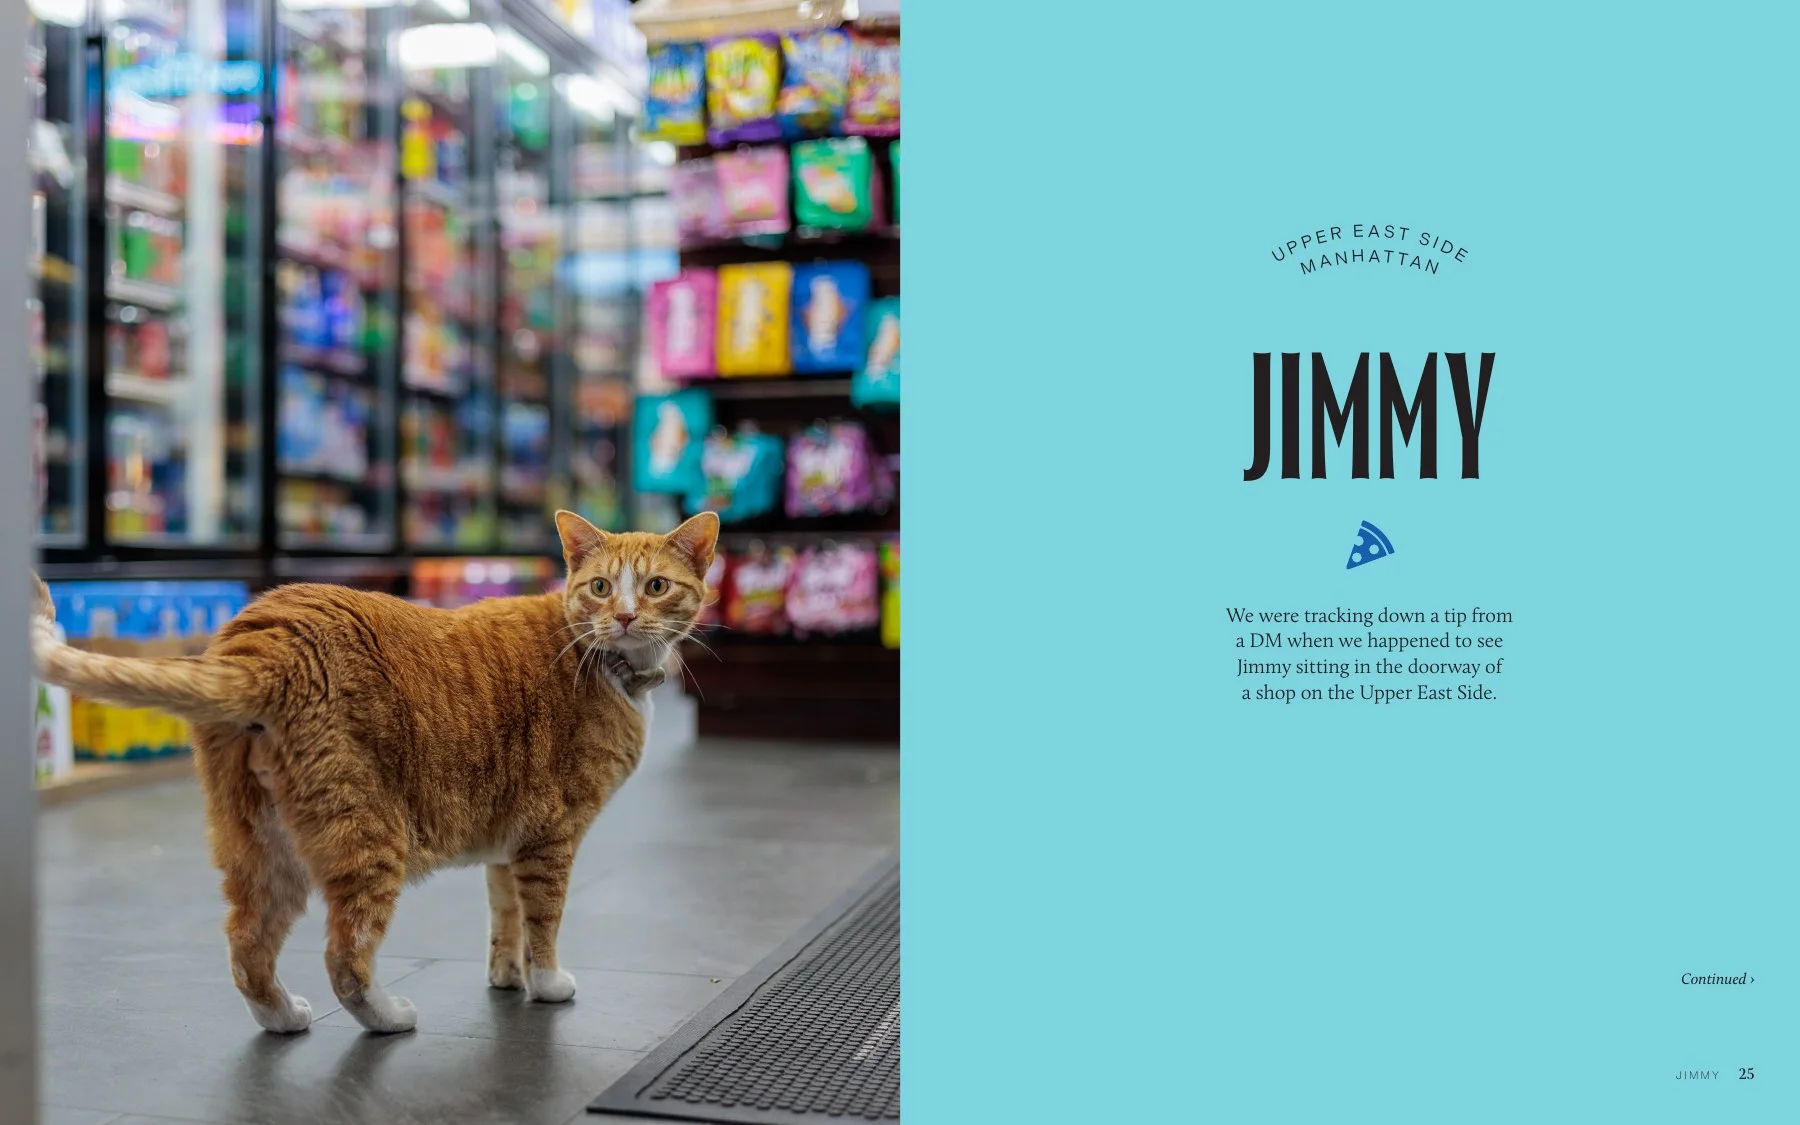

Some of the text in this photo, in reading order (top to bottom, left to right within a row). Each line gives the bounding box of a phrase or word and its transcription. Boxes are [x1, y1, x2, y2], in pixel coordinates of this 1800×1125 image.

[1272, 224, 1468, 262] UPPER EAST SIDE
[1300, 249, 1439, 274] MANHATTAN
[1243, 352, 1496, 481] JIMMY
[1226, 607, 1513, 627] We were tracking down a tip from
[1236, 632, 1503, 652] a DM when we happened to see
[1237, 658, 1504, 678] Jimmy sitting in the doorway of
[1242, 684, 1496, 704] a shop on the Upper East Side.
[1682, 972, 1747, 984] Continued
[1676, 1068, 1754, 1080] JIMMY 25
